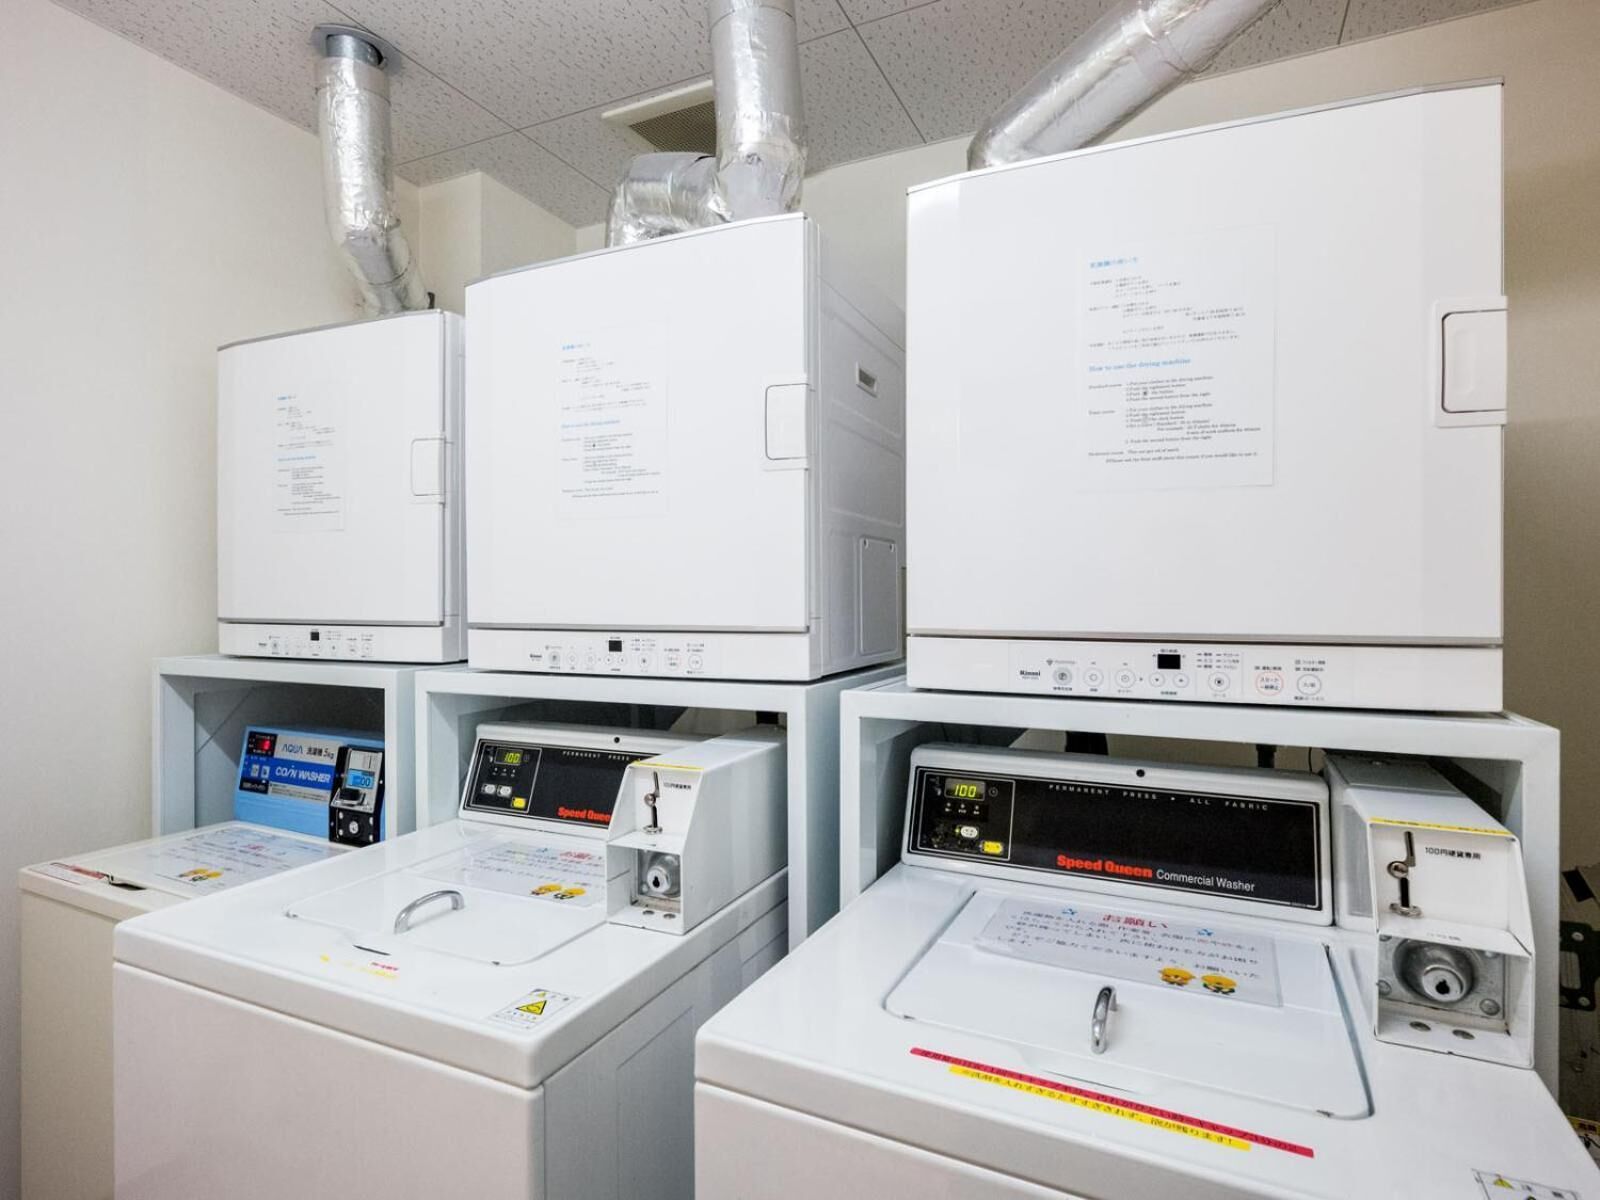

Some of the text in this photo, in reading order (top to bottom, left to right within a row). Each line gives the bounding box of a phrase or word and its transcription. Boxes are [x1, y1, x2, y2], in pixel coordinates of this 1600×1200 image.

[281, 743, 304, 754] AQUA
[504, 752, 521, 764] 100
[298, 769, 331, 784] WASHER
[954, 784, 977, 798] 100
[1049, 784, 1269, 812] PERMANENT PRESS ALL FABRIC
[558, 806, 587, 819] Speed
[1056, 855, 1255, 893] Speed Queen Commercial Washer
[1102, 908, 1169, 929] お願い
